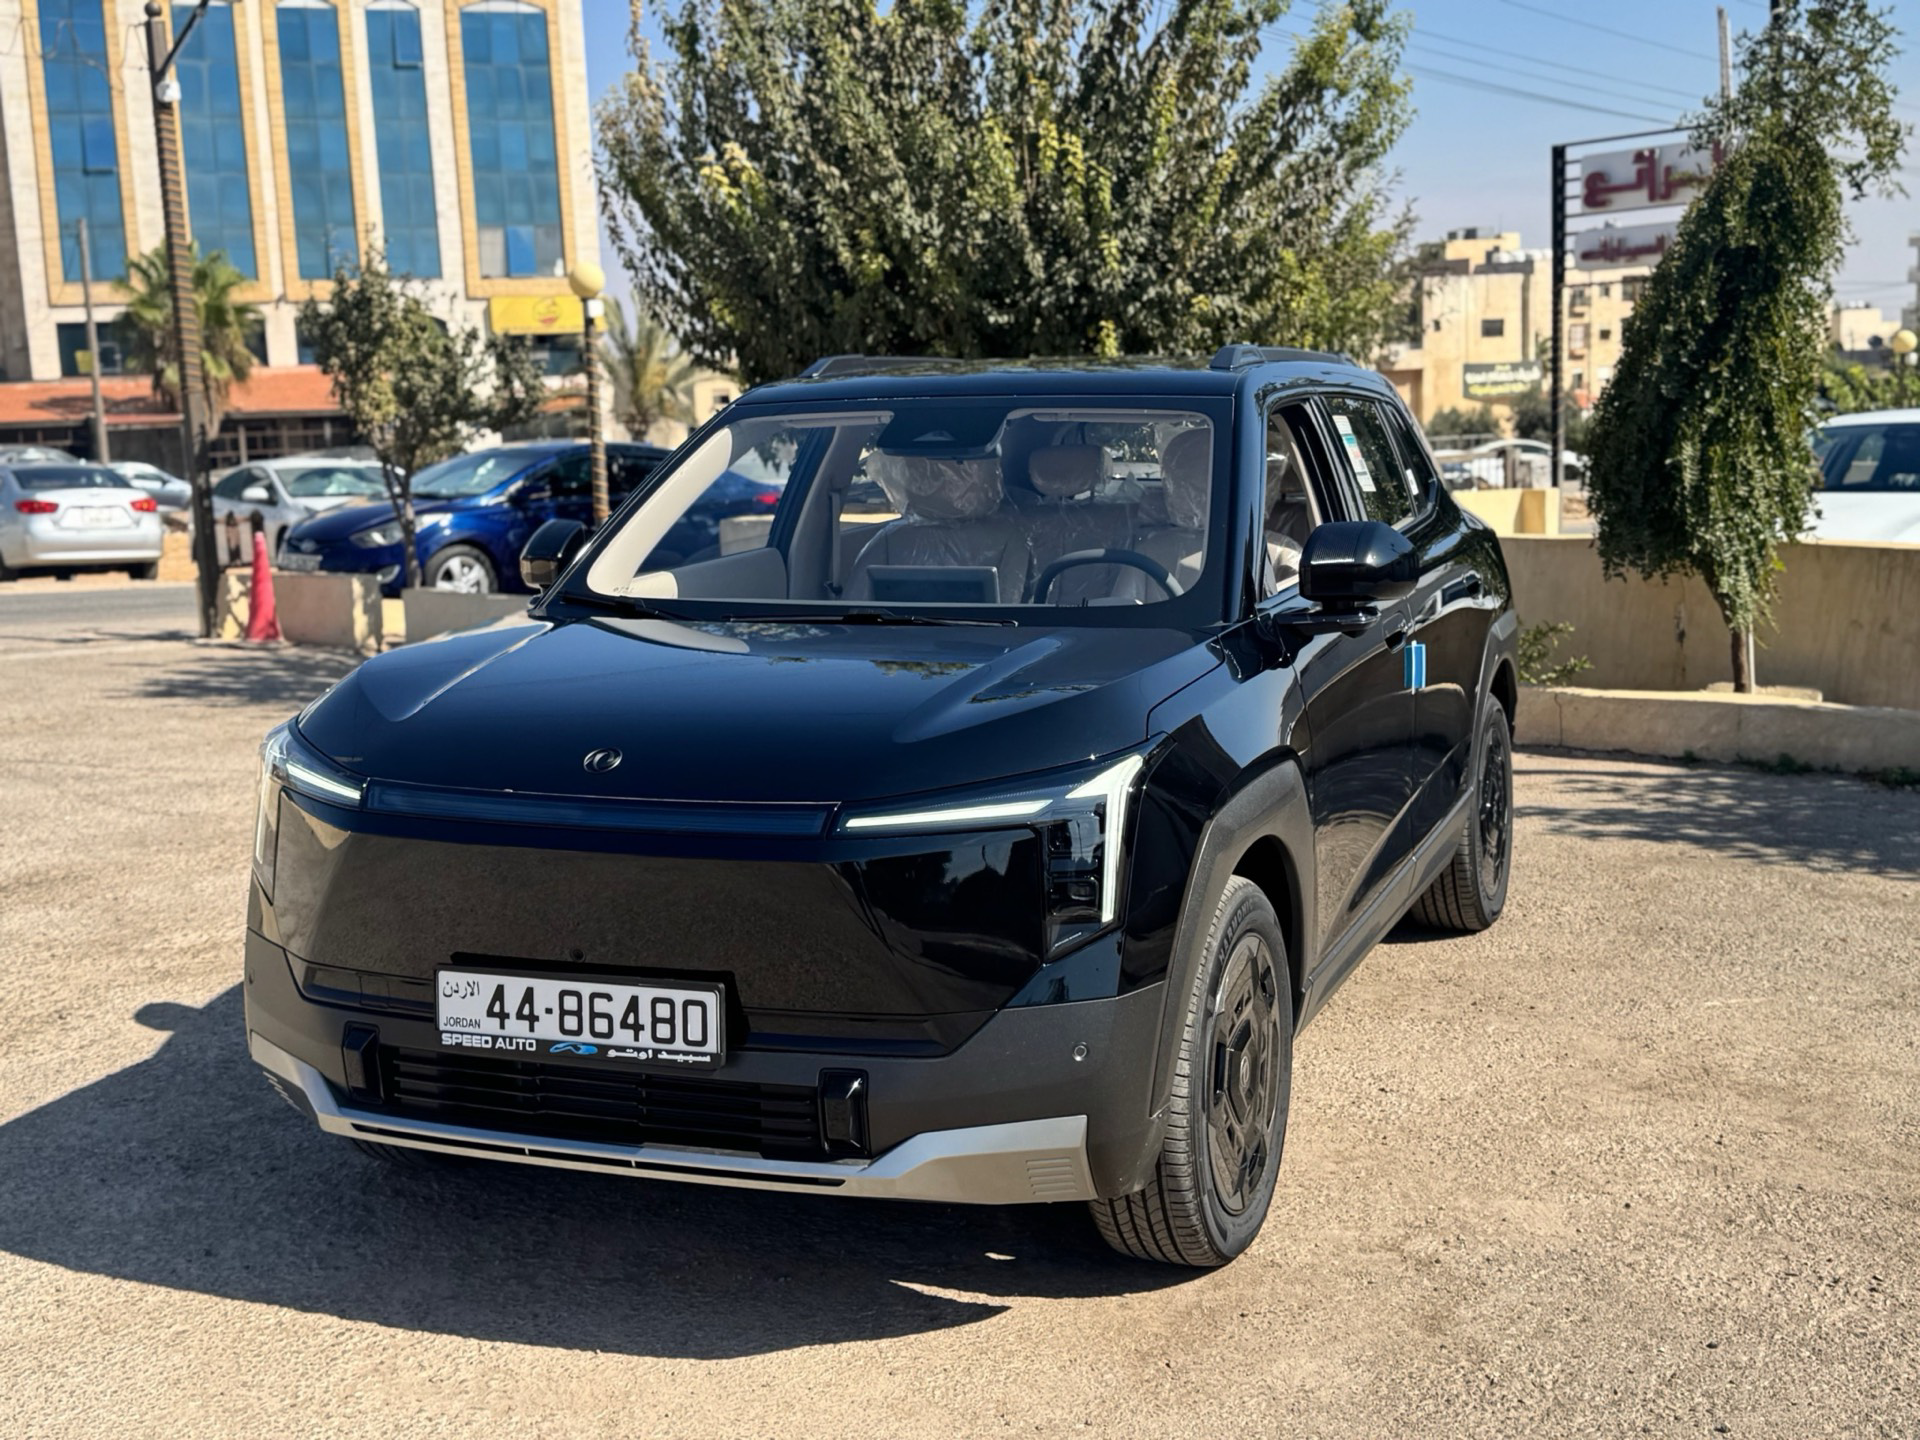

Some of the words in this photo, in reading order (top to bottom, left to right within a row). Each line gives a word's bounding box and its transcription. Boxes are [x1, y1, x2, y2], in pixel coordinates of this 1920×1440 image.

[442, 980, 480, 999] الاردن
[443, 1016, 481, 1029] JORDAN
[441, 1032, 493, 1049] SPEED
[495, 1037, 537, 1051] AUTO
[606, 1049, 653, 1060] اوتو
[658, 1051, 711, 1063] سبيد
